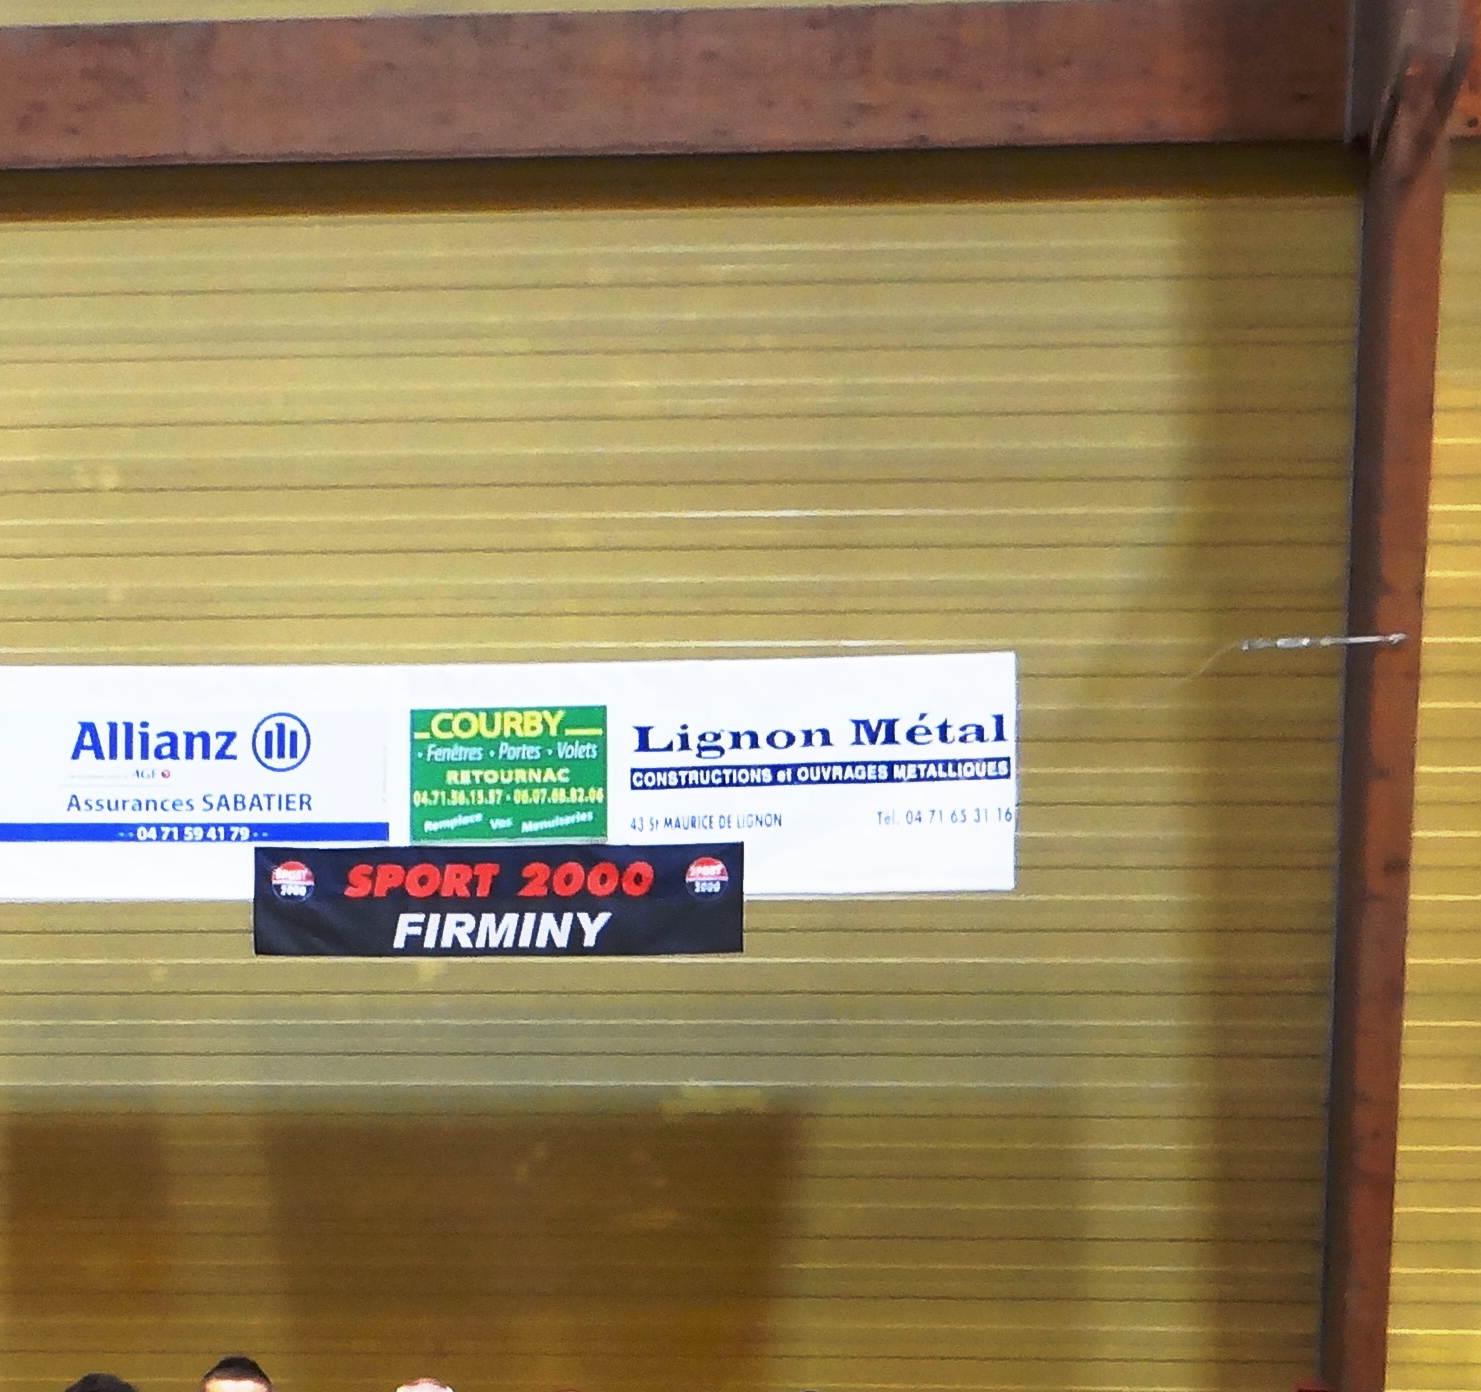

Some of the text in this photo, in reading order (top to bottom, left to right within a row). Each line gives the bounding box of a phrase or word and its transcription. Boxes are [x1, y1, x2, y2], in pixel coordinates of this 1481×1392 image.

[430, 709, 565, 739] COURBY
[632, 713, 1008, 759] Lignon Métal
[70, 720, 239, 762] Allianz
[498, 741, 541, 760] Portes
[556, 740, 598, 760] Volets
[446, 767, 570, 786] RETOURNAC
[632, 768, 772, 788] CONSTRUCTIONS
[796, 765, 889, 783] OUVRAGES
[893, 760, 1008, 780] METALLIQUES
[65, 792, 313, 813] Assurances SABATIER
[630, 816, 644, 833] 43
[663, 814, 714, 831] MAURICE
[718, 814, 732, 830] DE
[736, 812, 783, 830] LIGNON
[905, 809, 922, 825] 04
[929, 809, 943, 824] 71
[997, 807, 1013, 823] 16
[136, 826, 250, 841] 04 71 59 41 79
[344, 860, 655, 899] SPORT 2000
[393, 910, 613, 950] FIRMINY
